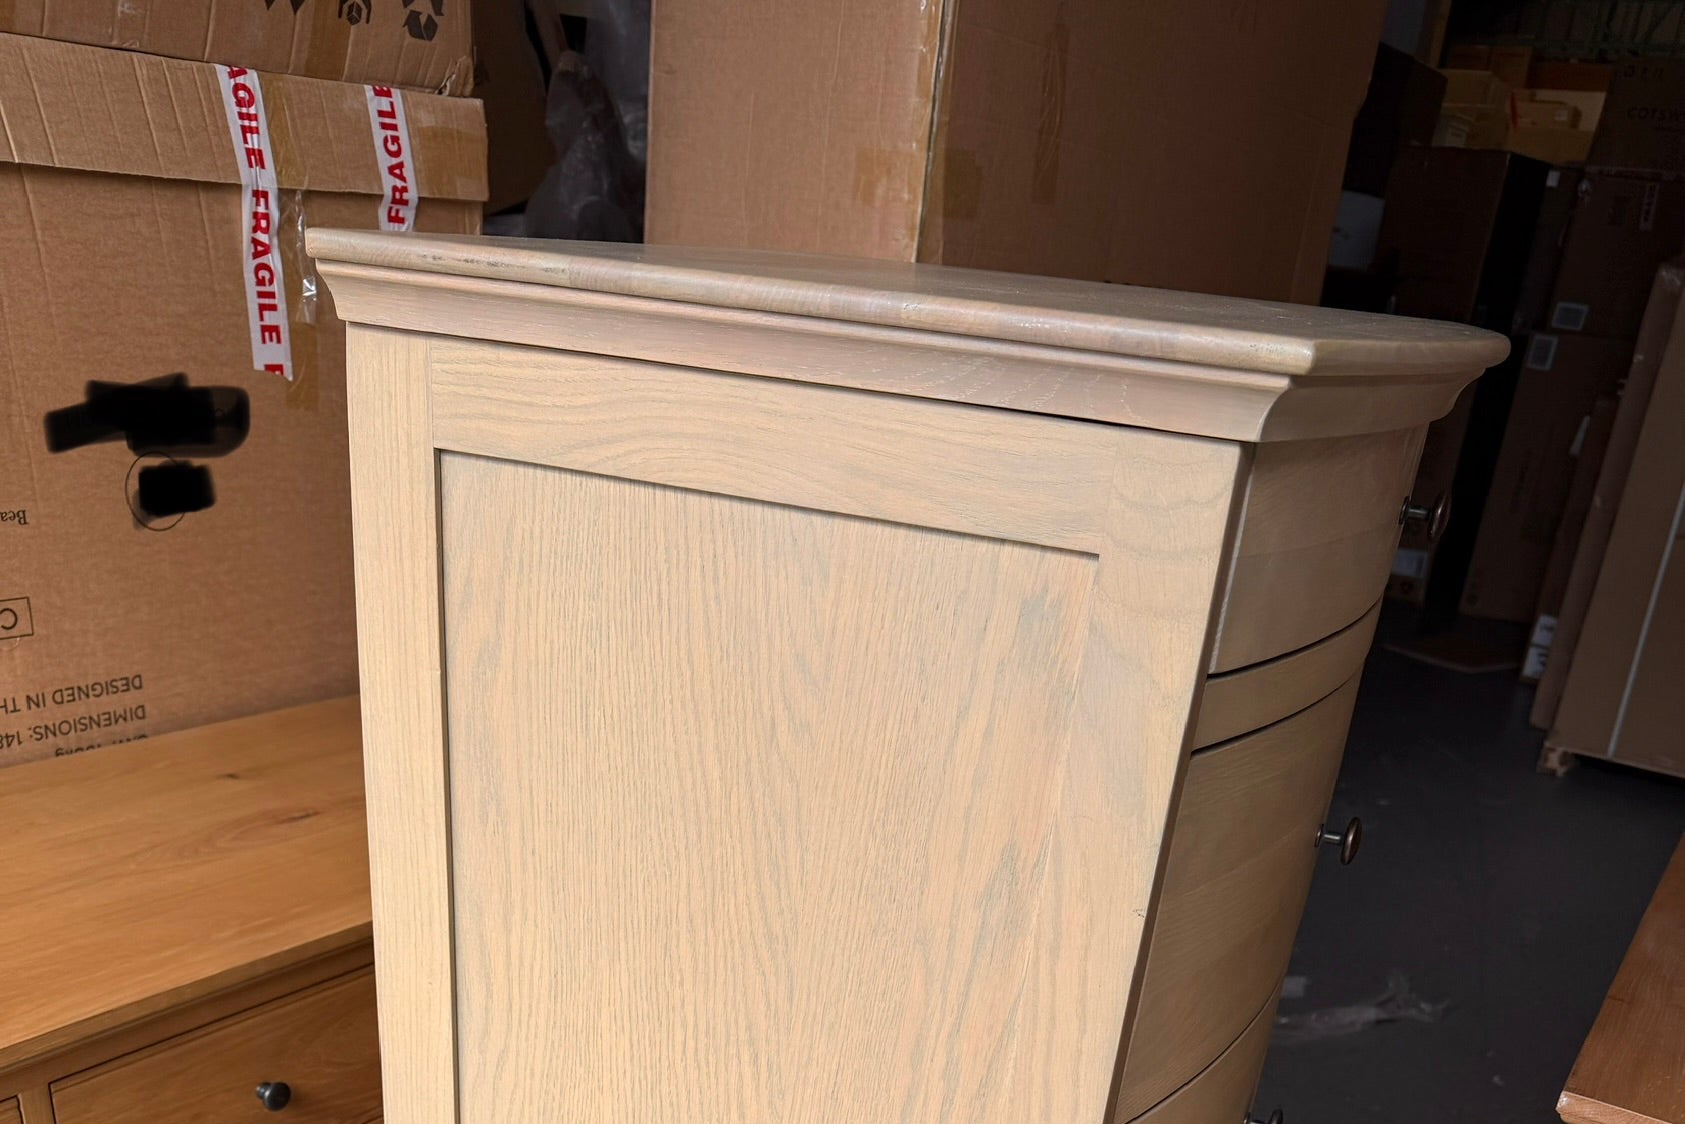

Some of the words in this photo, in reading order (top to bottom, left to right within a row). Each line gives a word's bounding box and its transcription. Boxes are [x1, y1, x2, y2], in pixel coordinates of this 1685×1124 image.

[251, 189, 282, 345] FRAGILE
[25, 691, 46, 711] IN
[51, 674, 143, 706] DESIGNED
[26, 704, 147, 741] DIMENSIONS:
